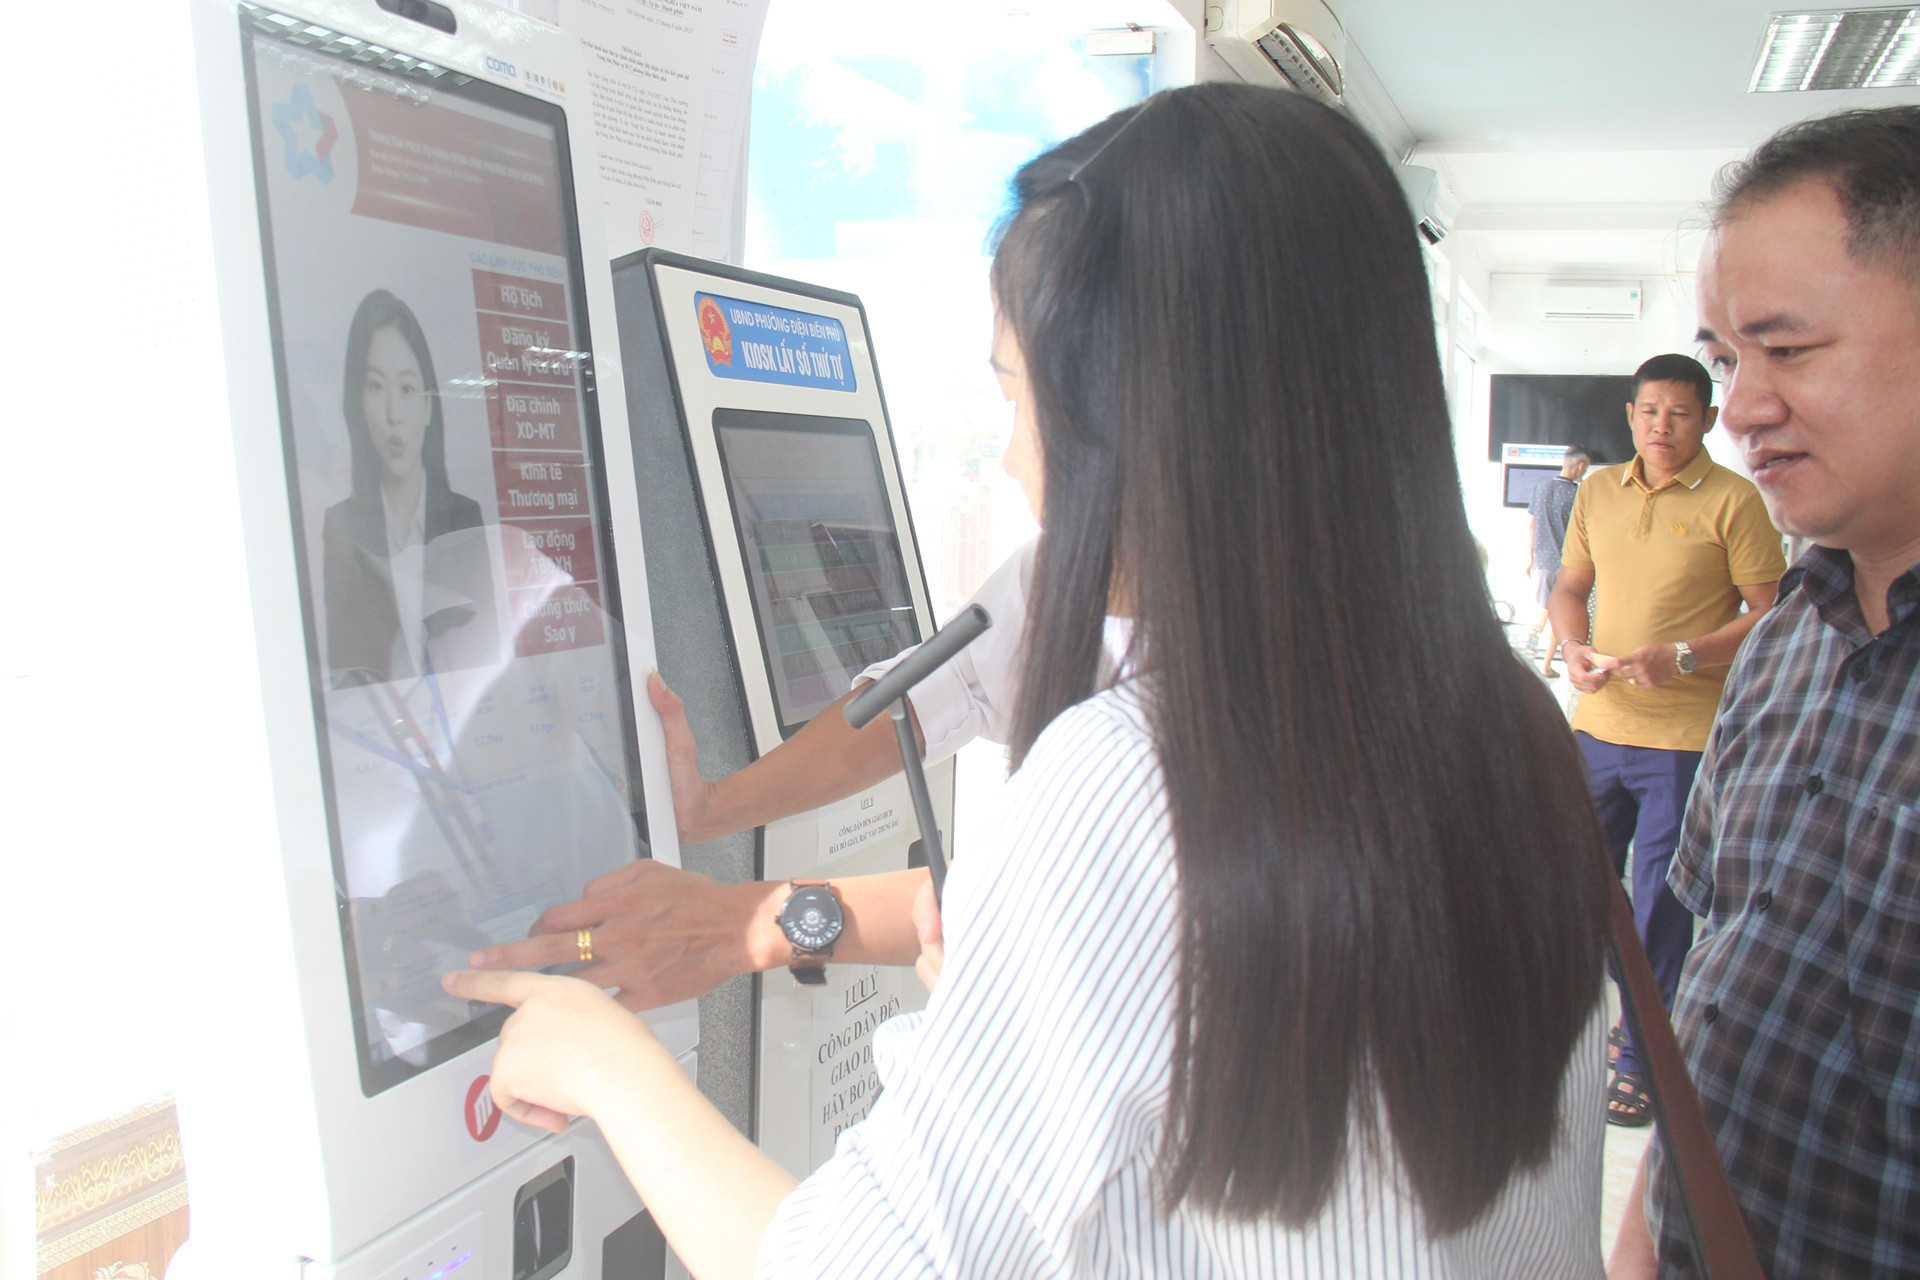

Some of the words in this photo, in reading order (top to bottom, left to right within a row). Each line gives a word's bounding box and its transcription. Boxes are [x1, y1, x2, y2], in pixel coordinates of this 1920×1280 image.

[500, 285, 518, 309] Hộ
[520, 289, 543, 311] tịch
[729, 308, 754, 327] UBND
[755, 312, 791, 334] PHƯỜNG
[790, 317, 810, 339] ĐIỆN
[809, 320, 826, 340] BIÊN
[826, 322, 841, 342] PHỦ
[741, 341, 778, 372] KIOSK
[775, 338, 796, 374] LẤY
[795, 342, 812, 377] SỐ
[810, 346, 832, 379] THỨ
[829, 355, 845, 386] TỰ
[505, 395, 527, 417] Địa
[528, 396, 561, 415] chính
[516, 421, 556, 440] XD-MT
[520, 463, 548, 481] Kinh
[508, 489, 555, 510] Thương
[557, 488, 578, 510] mại
[522, 531, 544, 549] Lao
[546, 528, 575, 552] động
[564, 596, 591, 617] thực
[544, 625, 566, 643] Sao
[568, 627, 576, 643] y
[844, 977, 869, 1009] LƯU
[868, 966, 879, 992] Ý
[818, 1031, 852, 1064] CÔNG
[853, 1010, 878, 1042] DÂN
[879, 994, 900, 1024] ĐẾN
[830, 1051, 860, 1086] GIAO
[862, 1041, 874, 1066] DỊ
[822, 1089, 848, 1125] HÃY
[848, 1073, 866, 1106] BỎ
[867, 1070, 882, 1092] GI
